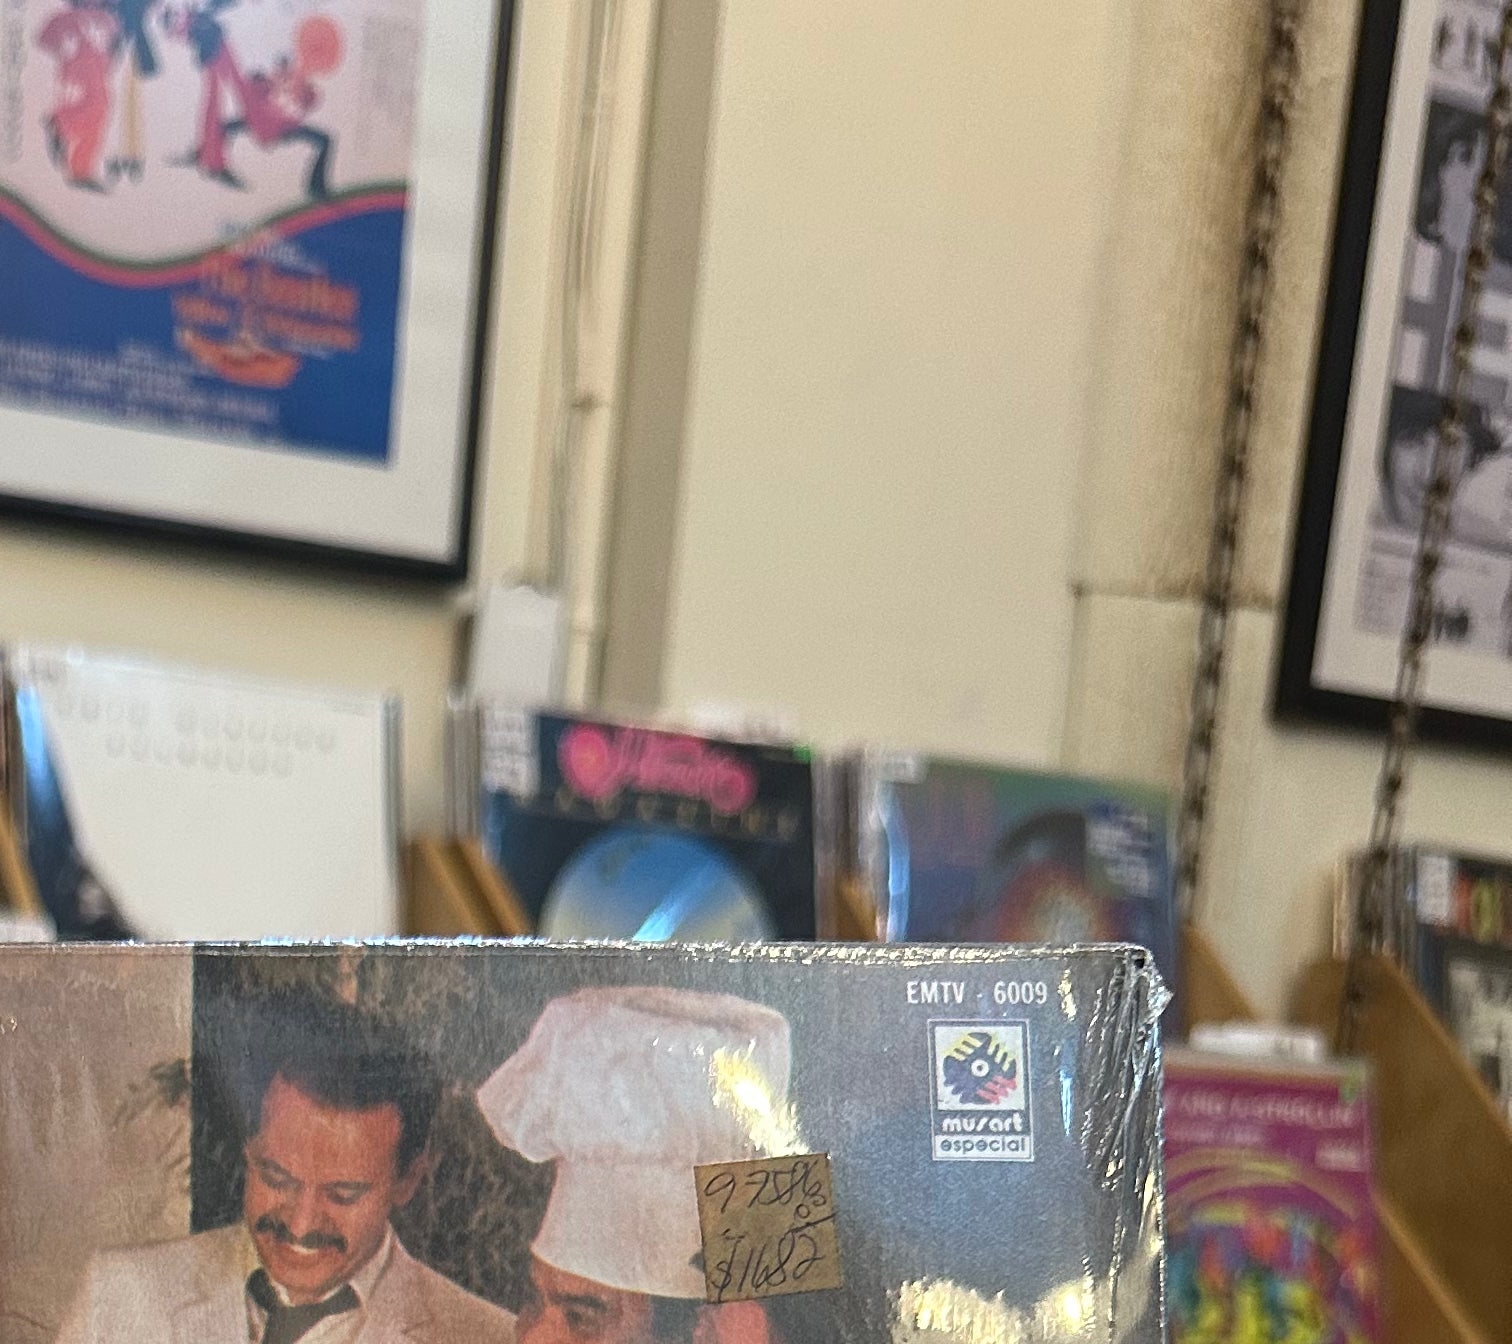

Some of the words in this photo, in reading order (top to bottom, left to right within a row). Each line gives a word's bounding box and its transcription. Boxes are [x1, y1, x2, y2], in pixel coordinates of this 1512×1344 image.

[907, 980, 966, 1005] EMTV
[993, 979, 1048, 1006] 6009
[941, 1115, 1024, 1133] musart
[940, 1137, 1027, 1156] especial
